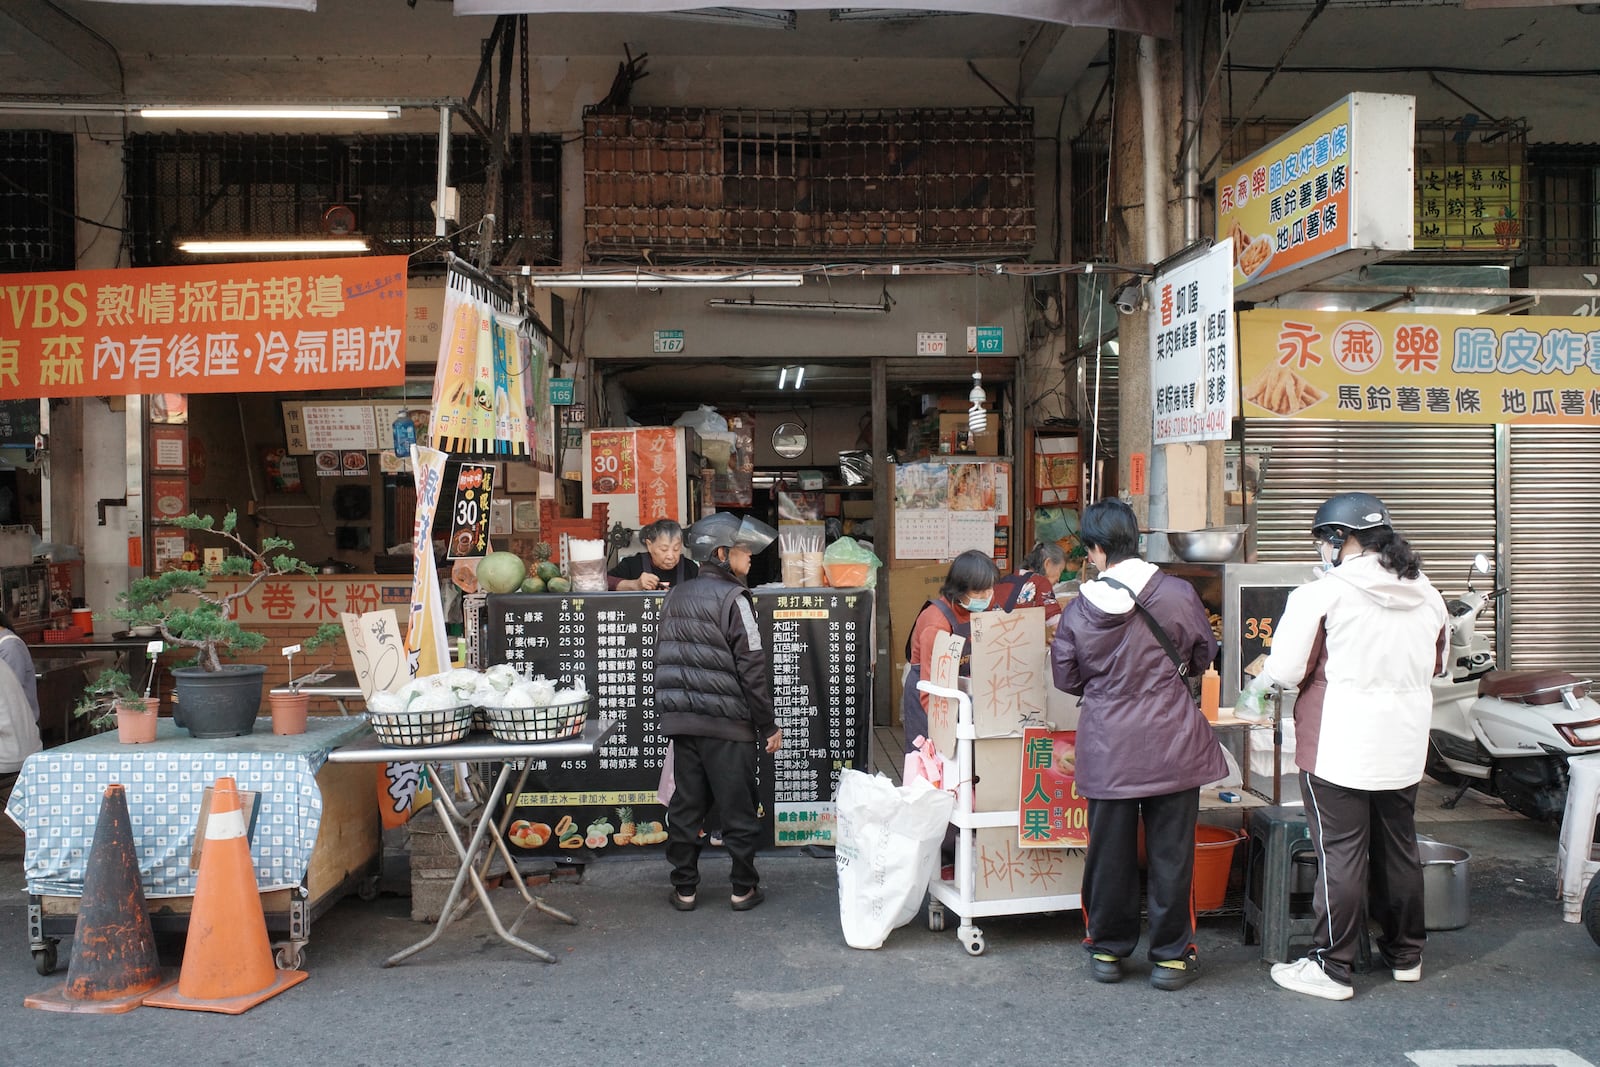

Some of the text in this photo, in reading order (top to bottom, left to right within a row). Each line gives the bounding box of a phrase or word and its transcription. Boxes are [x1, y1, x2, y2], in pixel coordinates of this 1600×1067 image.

[1221, 124, 1349, 215] 永燕樂 脆皮炸薯條
[1270, 164, 1346, 224] 馬鈴薯薯條
[1275, 203, 1337, 254] 地瓜薯條
[0, 283, 88, 329] VBS
[96, 274, 345, 328] 熱情採訪報導
[662, 339, 682, 350] 167
[927, 342, 944, 352] 107
[981, 339, 999, 349] 167
[1279, 321, 1440, 372] 永燕樂
[553, 391, 570, 400] 165
[1338, 385, 1481, 413] 馬鈴薯薯條
[1206, 411, 1216, 432] 40
[1216, 409, 1225, 431] 40
[594, 455, 618, 473] 30
[456, 500, 477, 526] 30
[476, 472, 491, 552] 龍眼干茶
[225, 583, 381, 621] 小卷米粉
[777, 596, 825, 608] 現打果汁
[559, 612, 571, 622] 25
[573, 612, 585, 622] 30
[641, 611, 653, 621] 40
[559, 625, 571, 634] 25
[573, 625, 585, 634] 30
[641, 624, 653, 633] 50
[773, 621, 855, 631] 木瓜汁 35 60
[1244, 617, 1273, 639] 35
[559, 637, 585, 646] 25 30
[641, 636, 653, 645] 50
[773, 632, 855, 642] 西瓜汁 35 60
[829, 643, 839, 652] 35
[845, 643, 855, 652] 60
[573, 649, 585, 658] 30
[641, 649, 653, 658] 50
[829, 654, 839, 662] 35
[845, 654, 855, 662] 60
[559, 662, 571, 671] 35
[573, 662, 585, 671] 40
[641, 661, 653, 670] 60
[773, 664, 855, 674] 芒果汁 35 60
[559, 674, 571, 683] 40
[641, 673, 653, 682] 50
[829, 676, 839, 684] 40
[845, 676, 855, 684] 65
[641, 686, 653, 695] 50
[774, 685, 855, 696] 木瓜牛奶 55 80
[642, 698, 654, 707] 45
[774, 696, 855, 706] 西瓜牛奶 55 80
[599, 710, 654, 720] 洛神花 35
[829, 707, 839, 716] 55
[845, 707, 855, 716] 80
[642, 723, 654, 731] 35
[830, 718, 840, 727] 55
[845, 718, 855, 727] 80
[830, 729, 840, 738] 55
[845, 729, 855, 738] 80
[642, 735, 654, 744] 40
[781, 739, 855, 749] 萄牛奶 60 90
[643, 747, 655, 756] 50
[830, 750, 840, 759] 70
[842, 750, 855, 759] 110
[561, 760, 573, 769] 45
[575, 760, 587, 769] 55
[643, 759, 655, 768] 55
[775, 760, 809, 770] 芒果冰沙
[1023, 737, 1054, 840] 情人果
